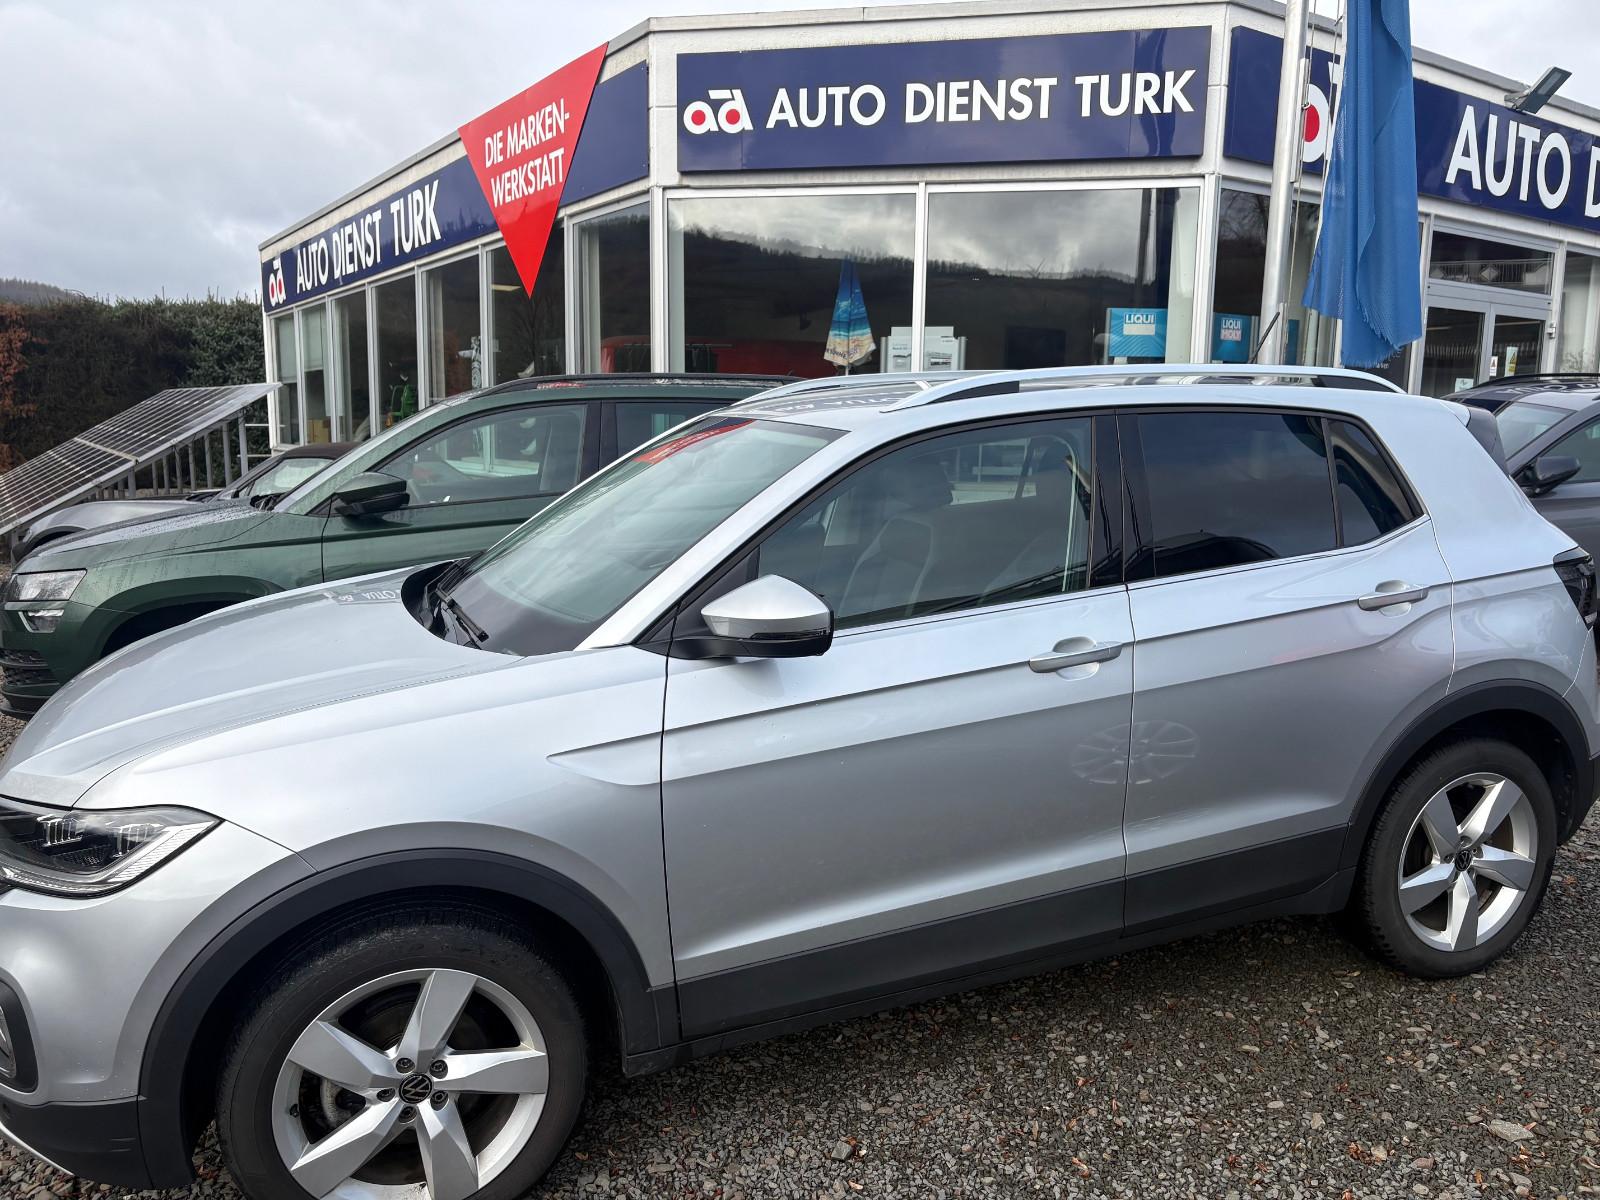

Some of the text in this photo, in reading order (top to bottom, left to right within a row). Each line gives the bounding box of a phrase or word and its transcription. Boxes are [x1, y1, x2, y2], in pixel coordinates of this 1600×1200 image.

[765, 84, 886, 129] AUTO
[905, 77, 1058, 123] DIENST
[1074, 69, 1197, 117] TURK
[485, 98, 570, 168] DIE MARKEN-
[1444, 104, 1572, 210] AUTO
[490, 147, 565, 208] WERKSTATT
[296, 237, 329, 294] AUTO
[332, 208, 382, 280] DIENST
[390, 179, 442, 257] TURK
[1125, 312, 1155, 325] LIQUI
[1222, 319, 1241, 330] LIQUI
